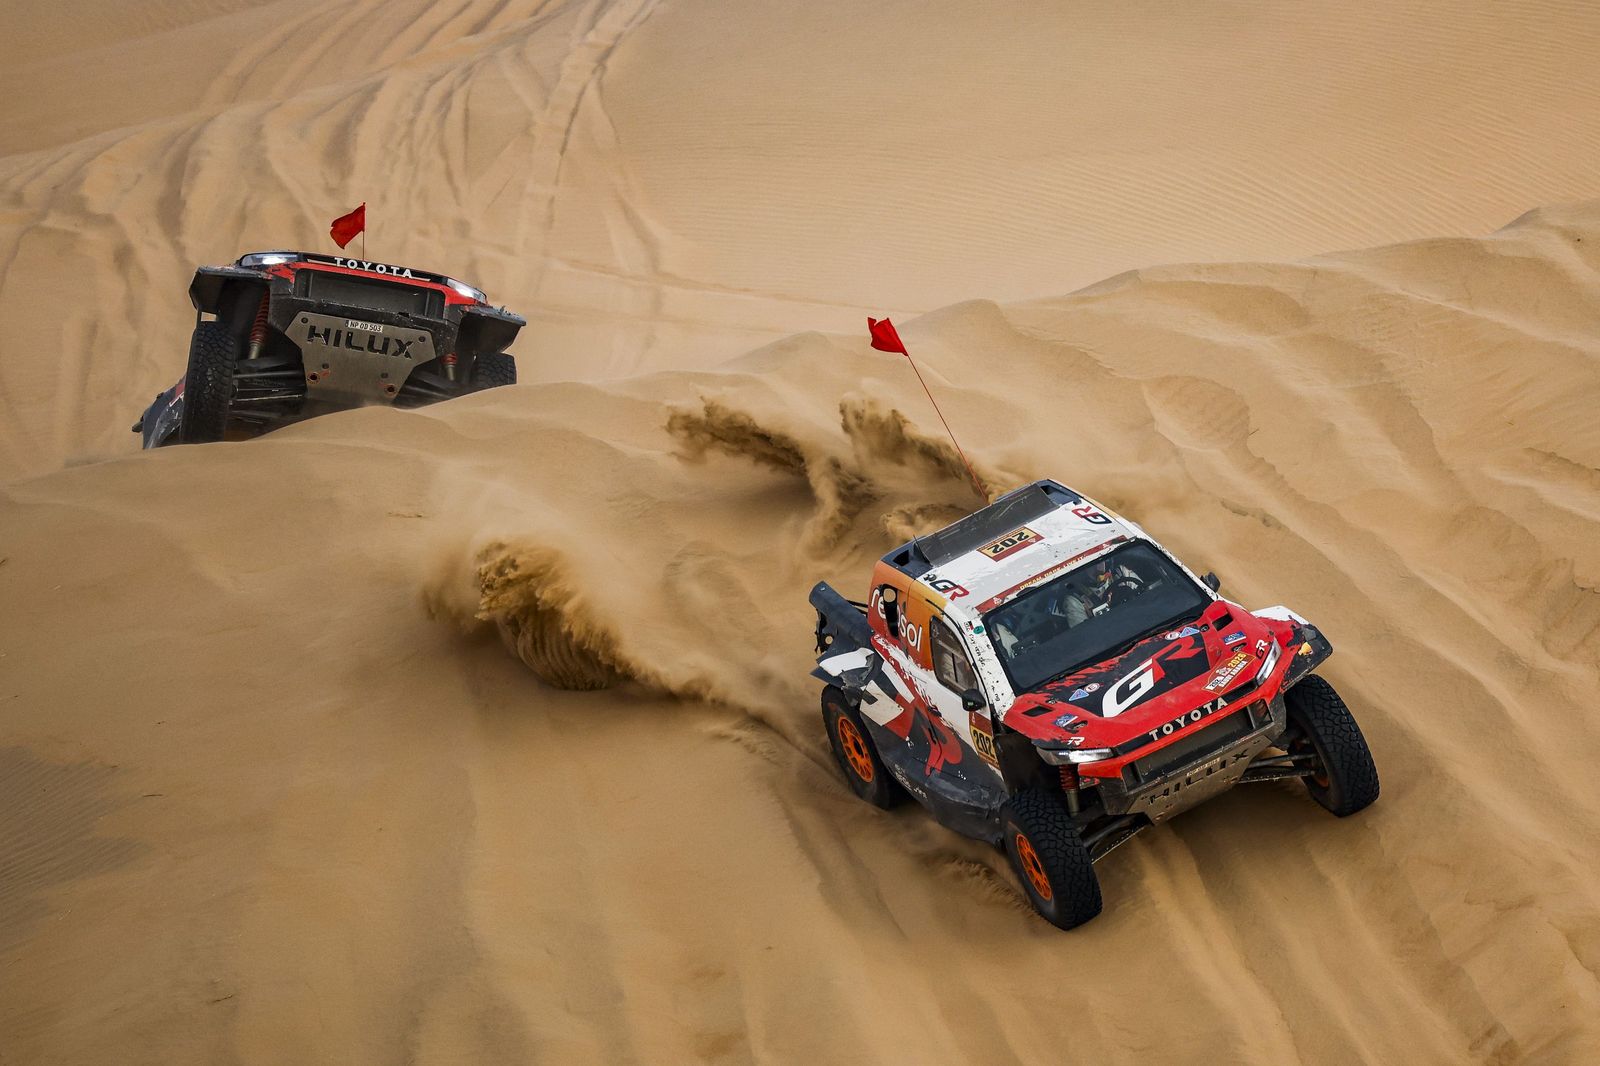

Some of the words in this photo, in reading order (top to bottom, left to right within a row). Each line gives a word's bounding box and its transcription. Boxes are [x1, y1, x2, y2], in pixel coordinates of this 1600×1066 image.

[333, 257, 413, 278] TOYOTA
[307, 325, 413, 359] HILUX
[1071, 506, 1112, 524] GR
[988, 531, 1030, 554] 202
[929, 579, 969, 601] GR
[871, 589, 922, 652] resol
[1228, 653, 1246, 668] 2026
[1255, 639, 1268, 659] GR
[1102, 635, 1205, 718] GR
[1149, 697, 1229, 741] TOYOTA
[1147, 748, 1248, 805] HILUX
